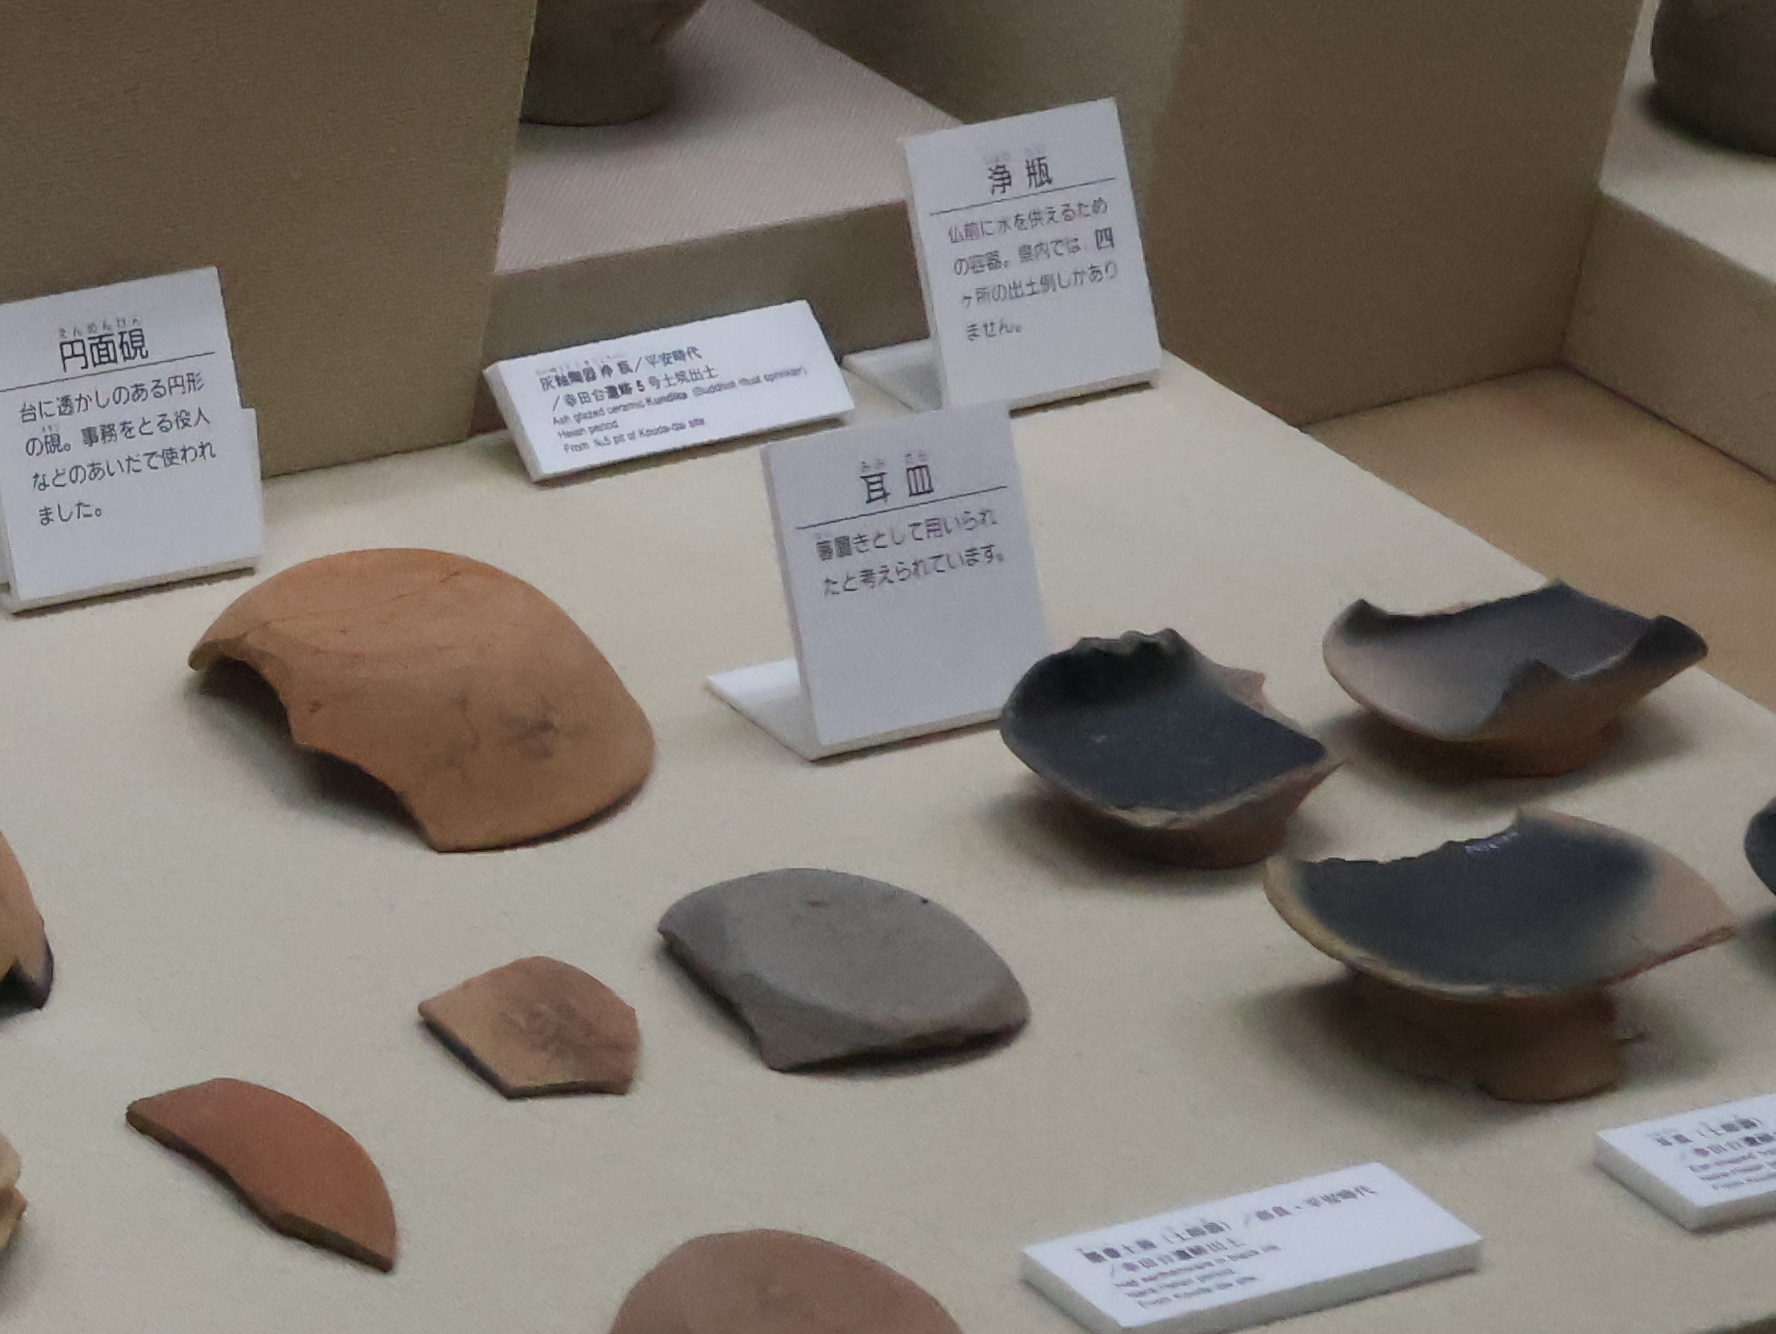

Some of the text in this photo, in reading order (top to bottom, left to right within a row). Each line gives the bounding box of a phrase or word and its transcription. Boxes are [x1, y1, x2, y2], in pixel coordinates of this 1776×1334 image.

[59, 328, 149, 373] 円面硯
[966, 319, 1023, 342] ません。
[19, 372, 206, 424] 台に透かしのある円形
[32, 441, 217, 492] などのあいだで使われ
[38, 500, 103, 527] ました。
[823, 543, 1004, 597] たと考えられています。
